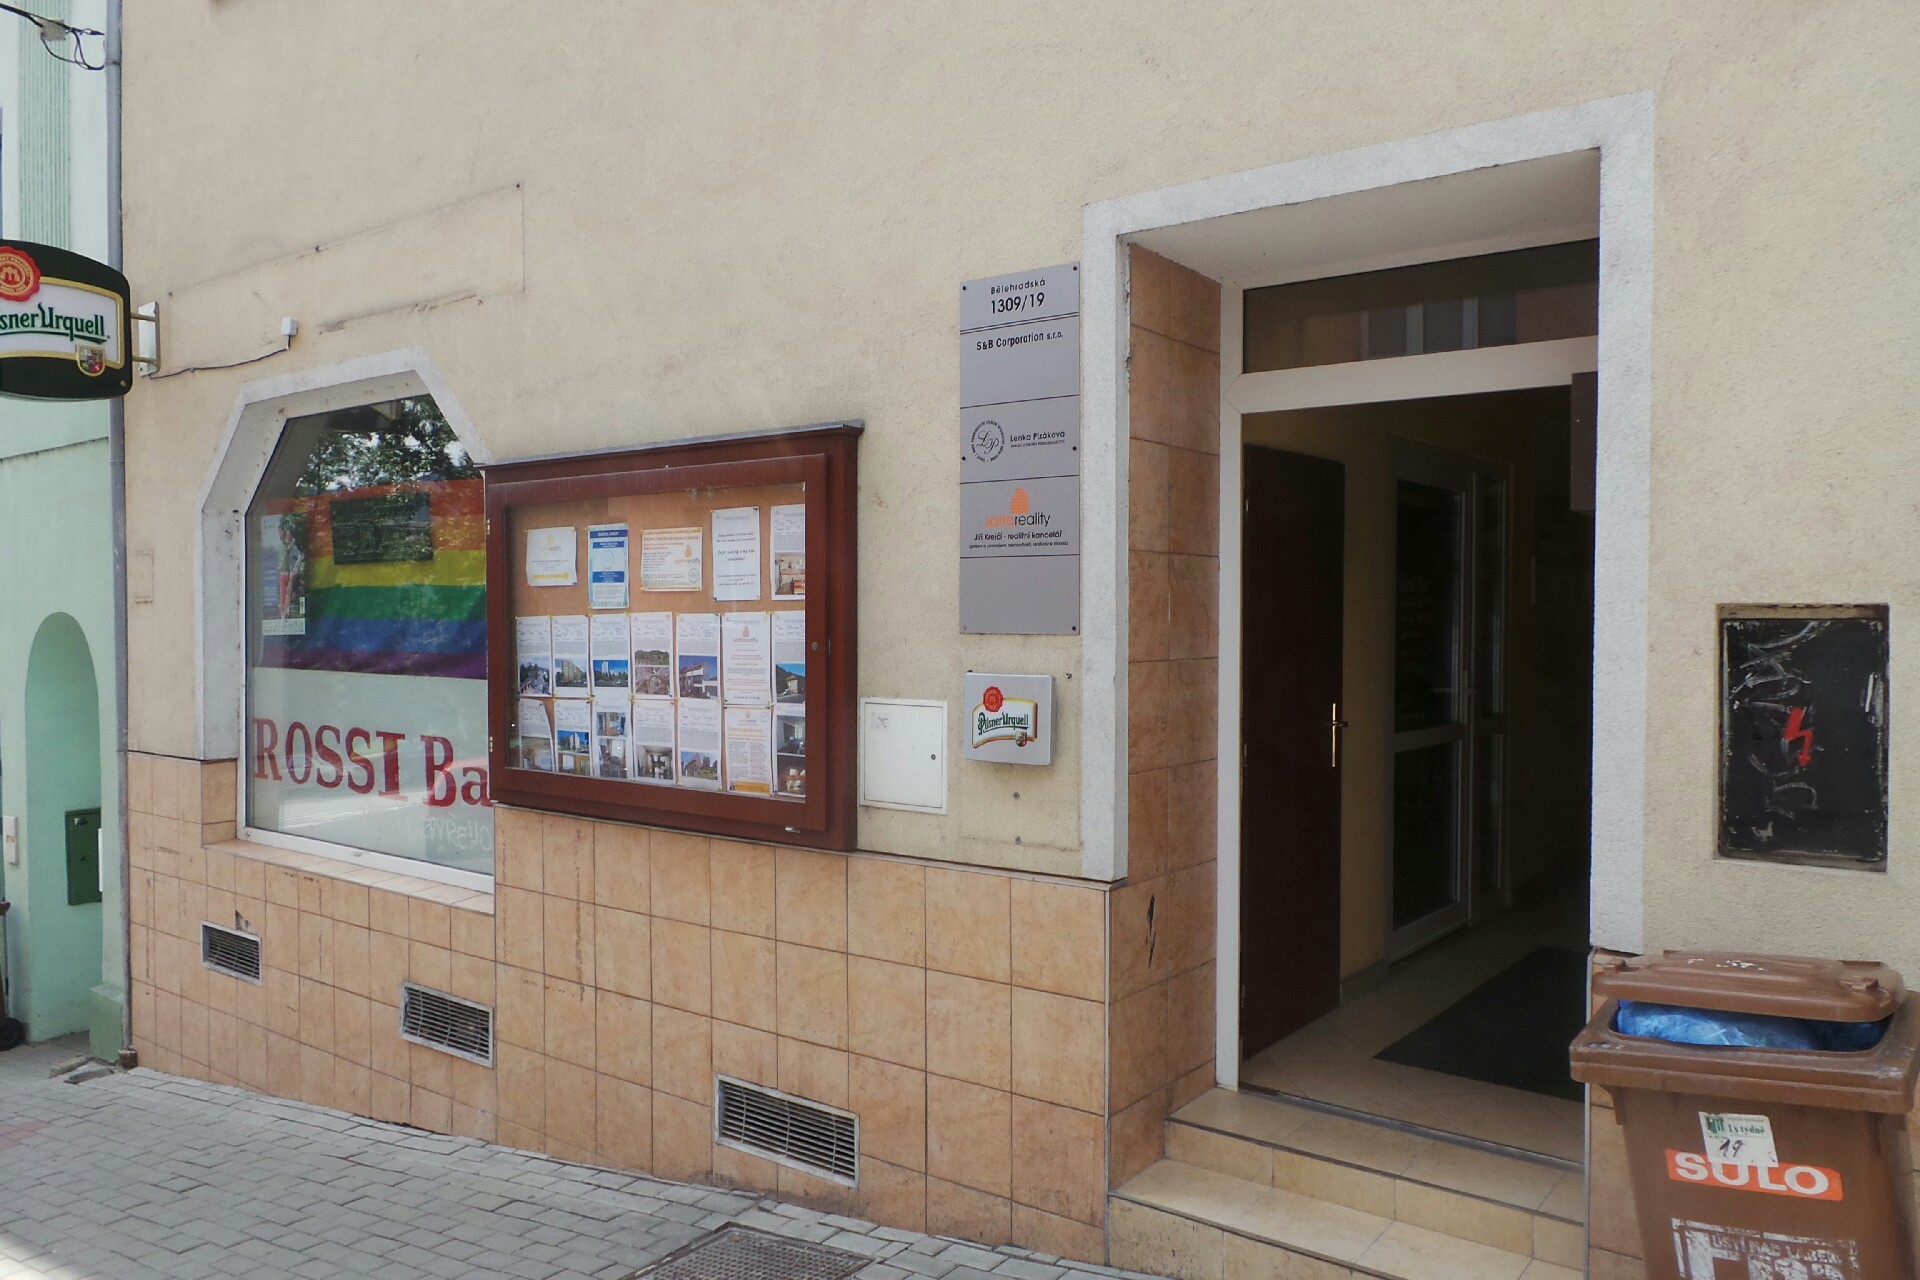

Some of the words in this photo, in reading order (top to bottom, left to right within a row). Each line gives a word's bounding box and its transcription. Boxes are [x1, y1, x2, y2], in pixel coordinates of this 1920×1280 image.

[991, 292, 1045, 314] 1309/19
[0, 312, 39, 330] sner
[37, 302, 105, 342] Urquell
[976, 340, 994, 351] S&B
[996, 332, 1044, 348] Corporation
[1046, 331, 1064, 340] s.r.o.
[1010, 434, 1031, 442] Lenka
[984, 532, 1003, 542] Krejčí
[1007, 531, 1030, 540] realitní
[1031, 530, 1063, 539] kancelář
[977, 712, 1002, 736] Pilsner
[1001, 712, 1029, 730] Urquell
[252, 716, 408, 802] ROSSI
[420, 734, 493, 807] Ba
[1674, 1151, 1830, 1196] SULO
